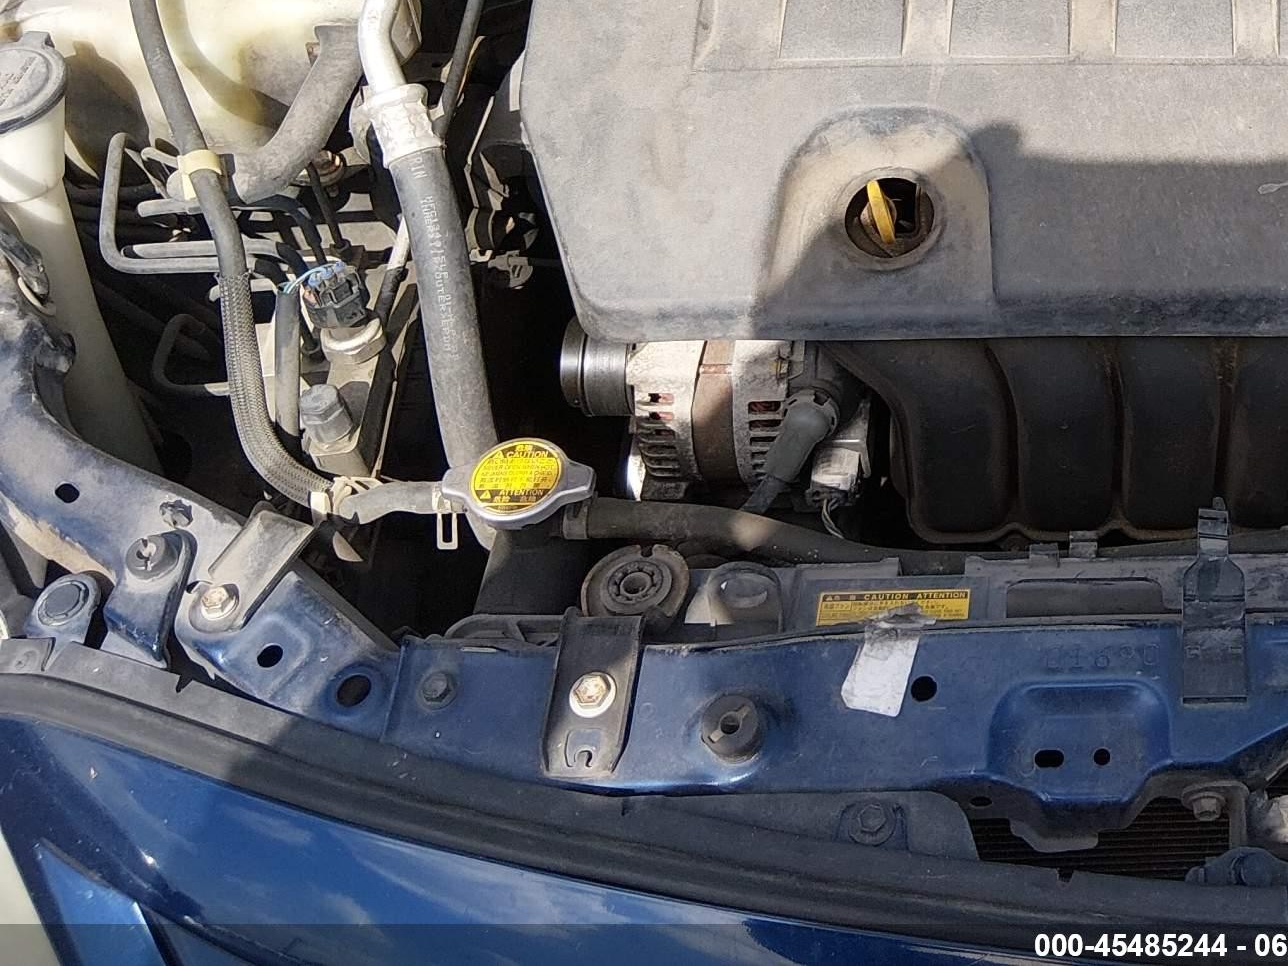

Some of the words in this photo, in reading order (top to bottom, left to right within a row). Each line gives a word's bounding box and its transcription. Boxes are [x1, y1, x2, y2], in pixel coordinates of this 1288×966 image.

[506, 450, 549, 459] CAUTION
[499, 489, 544, 497] ATTENTION
[864, 593, 909, 601] CAUTION
[916, 592, 966, 600] ATTENTION
